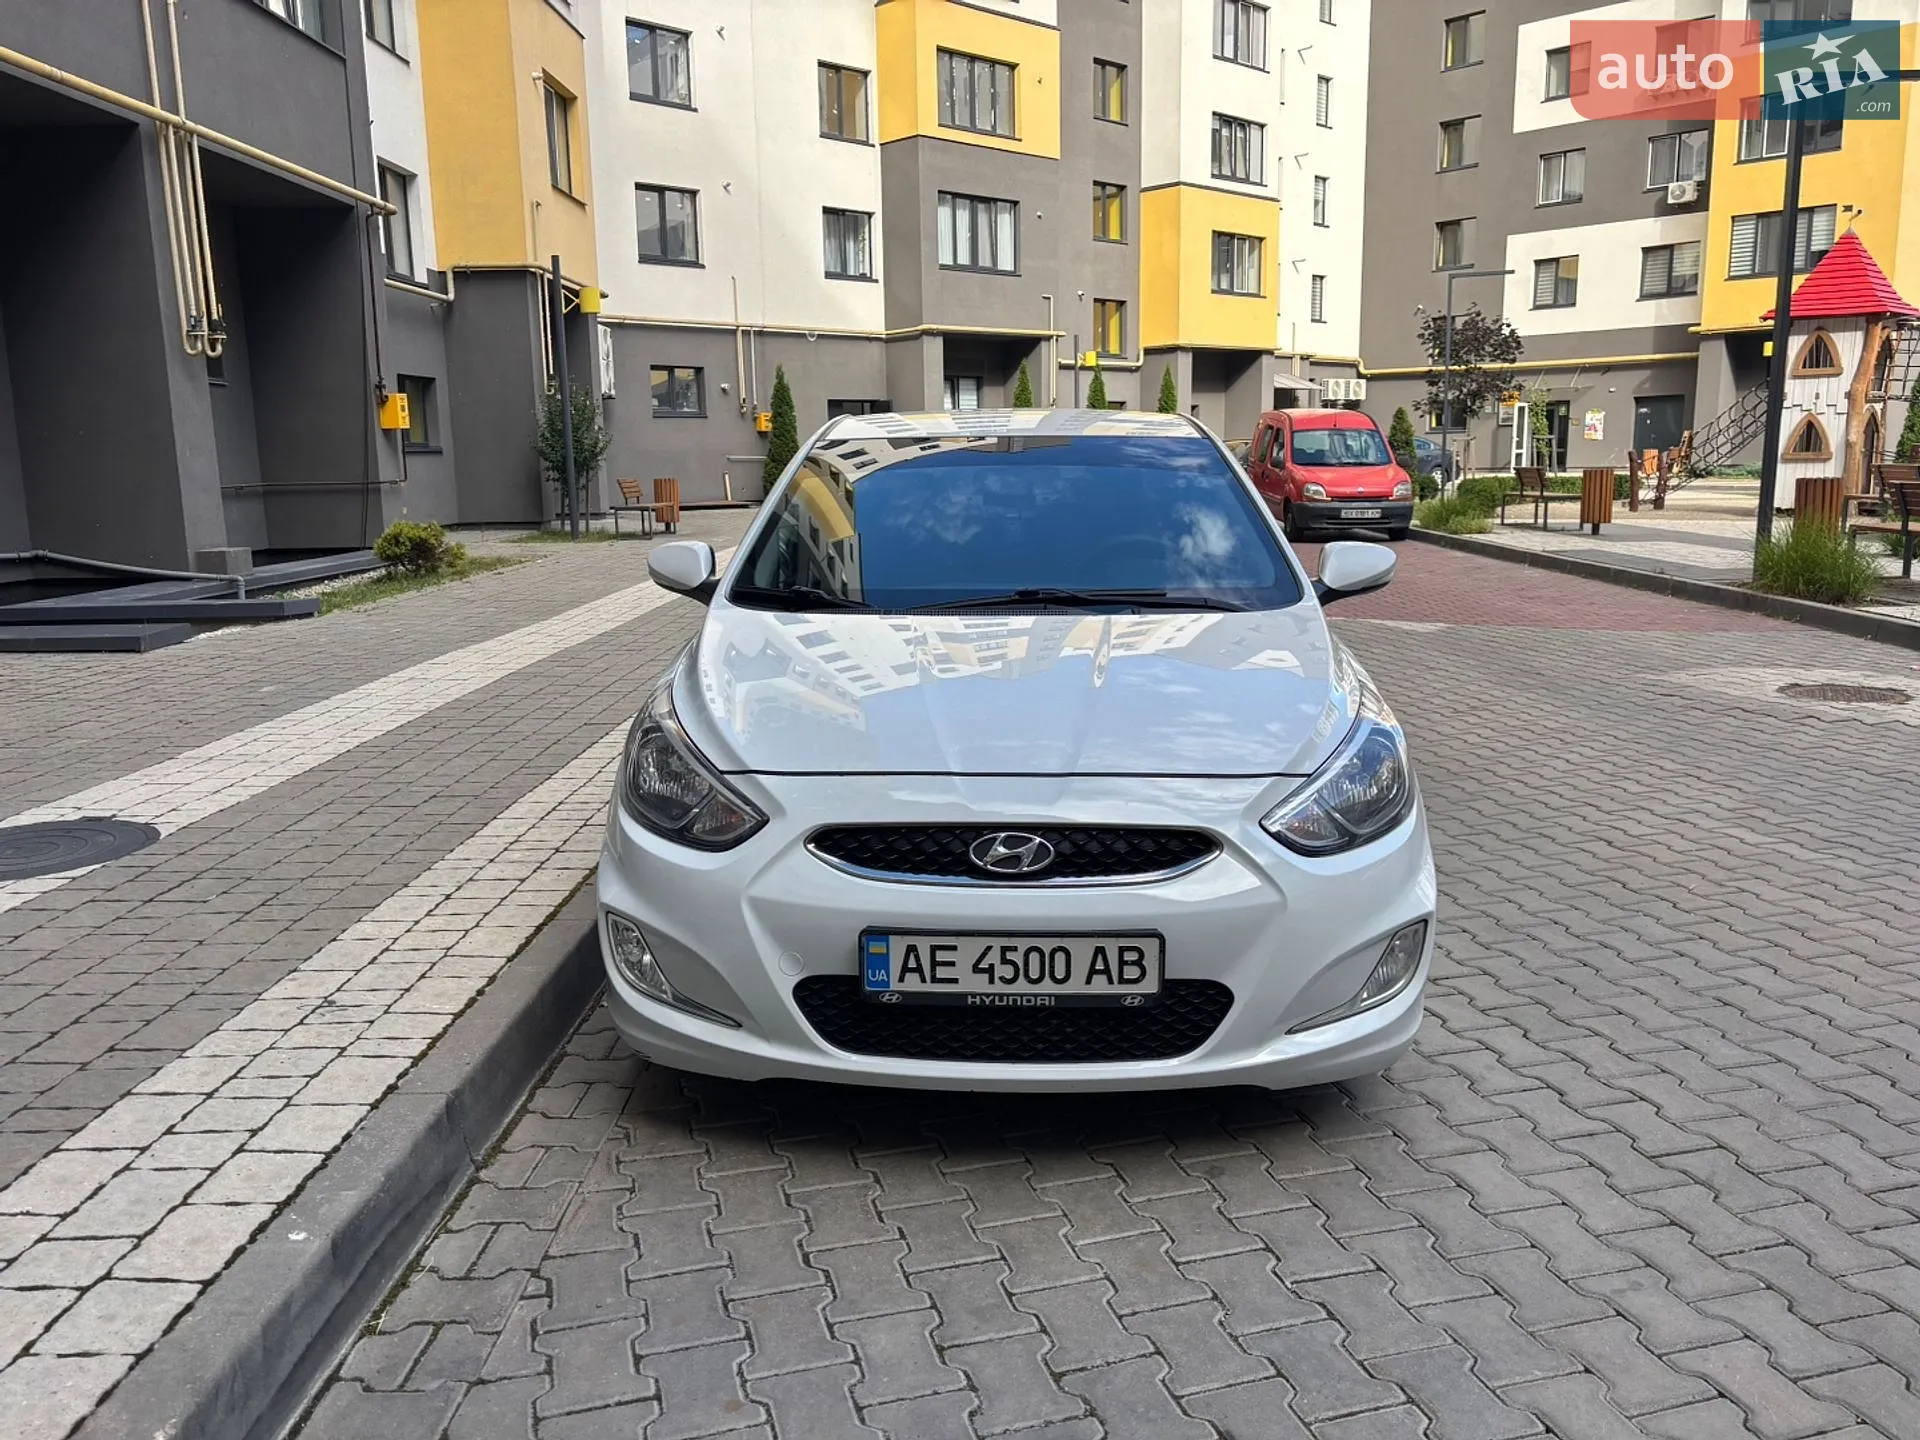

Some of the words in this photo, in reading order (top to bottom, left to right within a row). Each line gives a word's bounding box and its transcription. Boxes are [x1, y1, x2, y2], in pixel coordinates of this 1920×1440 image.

[897, 944, 960, 985] AE
[971, 945, 1072, 985] 4500
[1084, 945, 1147, 986] AB
[868, 969, 888, 981] UA
[967, 995, 1055, 1006] HYUNDAI
